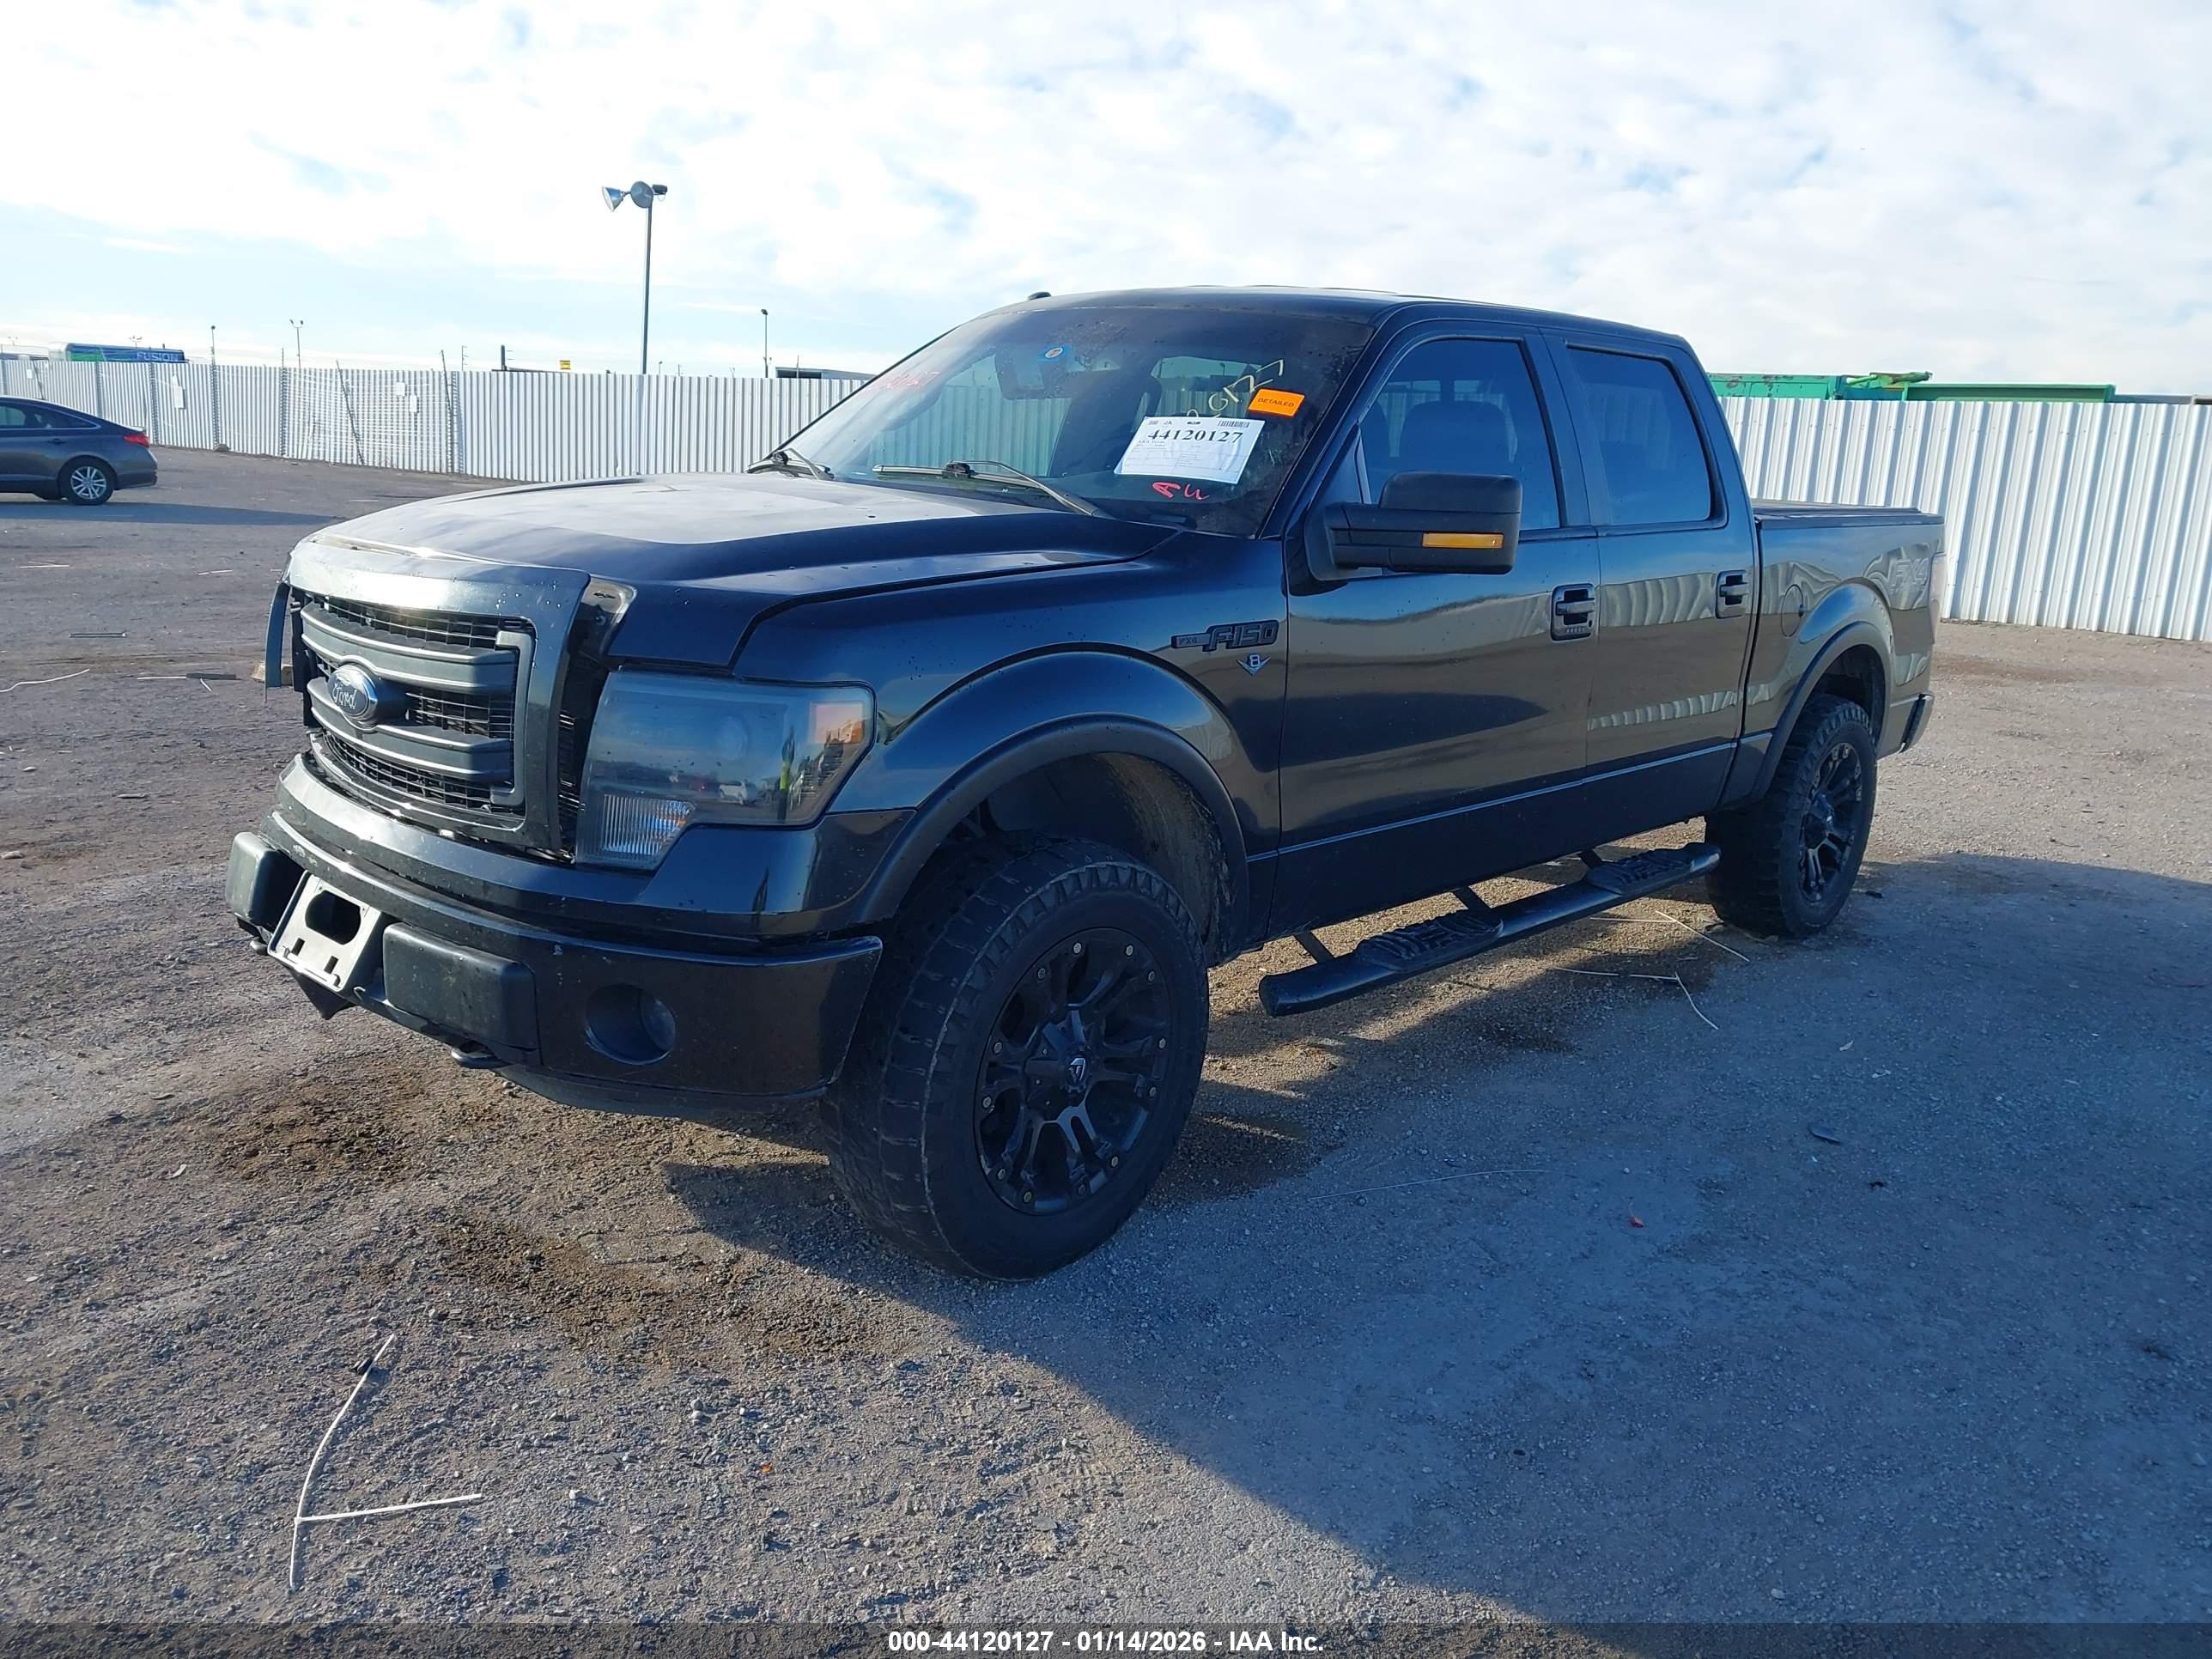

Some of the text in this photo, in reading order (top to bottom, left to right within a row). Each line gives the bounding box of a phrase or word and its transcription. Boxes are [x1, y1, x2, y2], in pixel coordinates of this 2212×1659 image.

[137, 351, 179, 362] FUSION
[1257, 397, 1295, 408] DETAILED
[1147, 428, 1243, 444] 44120127
[1887, 557, 1929, 586] FX4
[331, 681, 358, 710] Ford
